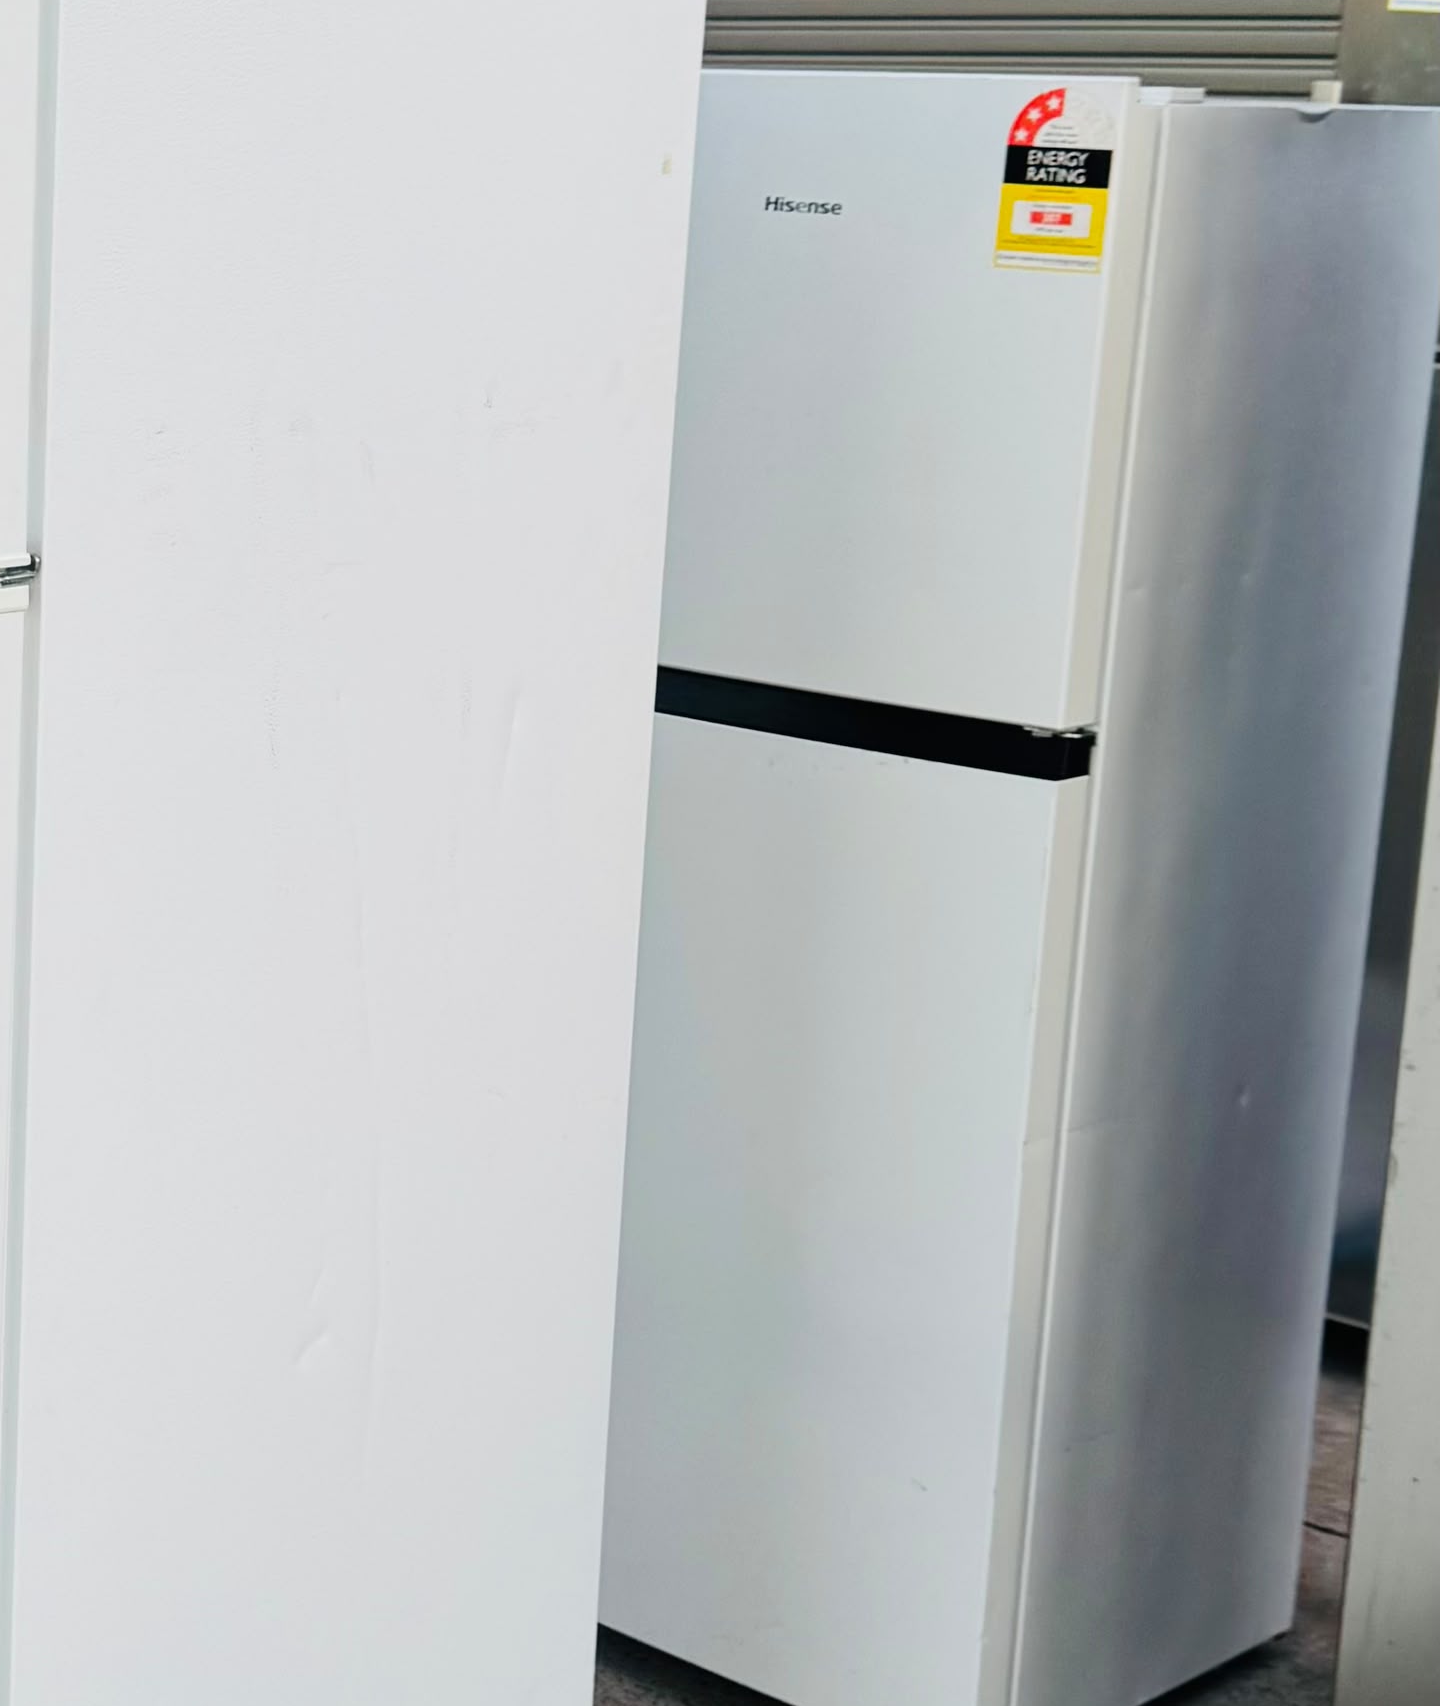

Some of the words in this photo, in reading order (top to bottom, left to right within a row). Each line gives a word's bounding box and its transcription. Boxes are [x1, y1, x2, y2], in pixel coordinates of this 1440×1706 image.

[1027, 149, 1090, 167] ENERGY
[1025, 166, 1087, 185] RATING
[764, 196, 843, 216] Hisense
